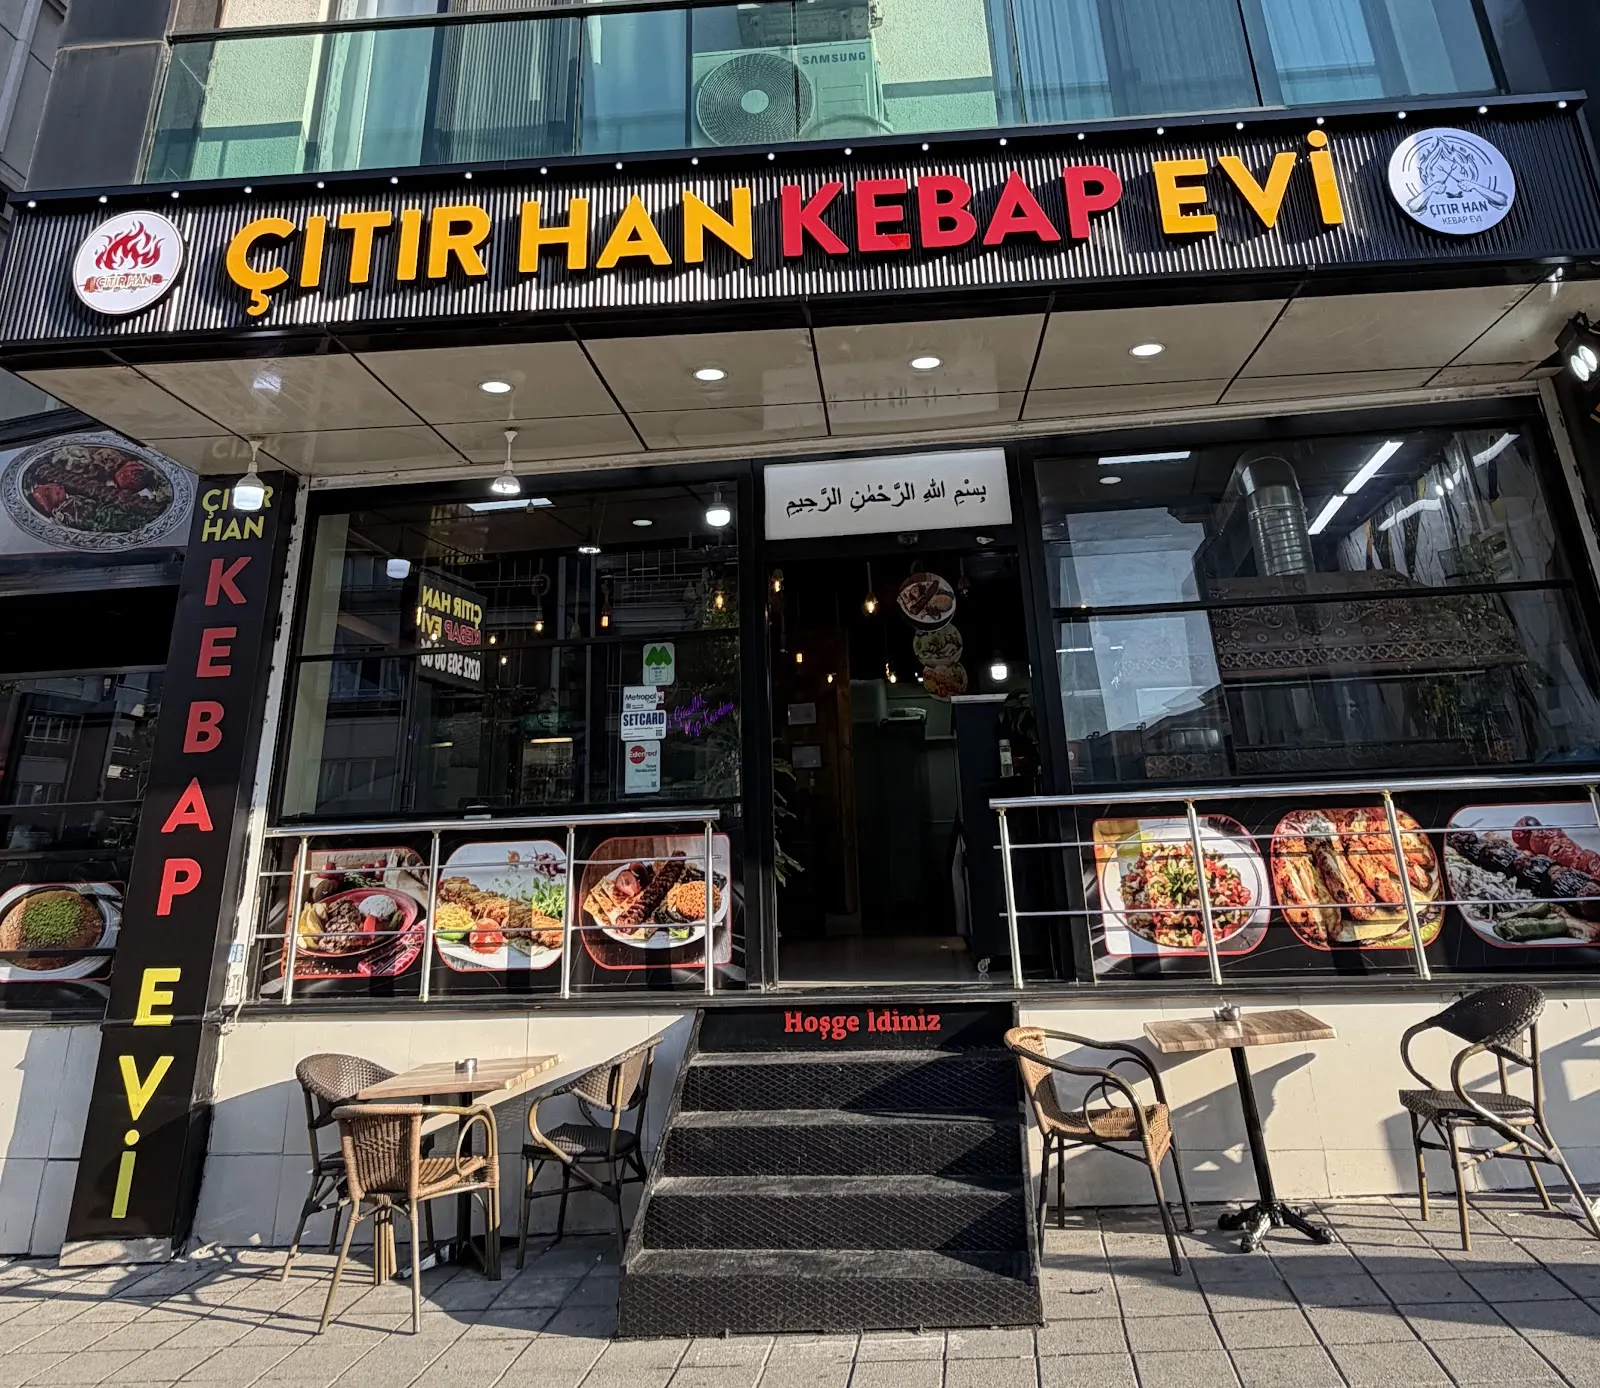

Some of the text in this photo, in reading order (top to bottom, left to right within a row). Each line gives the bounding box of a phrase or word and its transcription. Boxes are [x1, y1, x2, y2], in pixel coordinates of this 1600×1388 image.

[802, 51, 866, 65] SAMSUNG
[1430, 200, 1488, 218] ÇITIR HAN
[1442, 215, 1468, 225] KEBAP
[226, 205, 489, 315] ÇITIR
[519, 187, 751, 272] HAN
[782, 165, 1121, 256] KEBAP
[128, 274, 153, 288] HAN
[202, 486, 274, 519] ÇIR
[201, 515, 265, 542] HAN
[625, 692, 657, 702] Metropol
[623, 712, 665, 727] SETCARD
[156, 556, 252, 916] KEBAP
[784, 1010, 860, 1041] Hoşge
